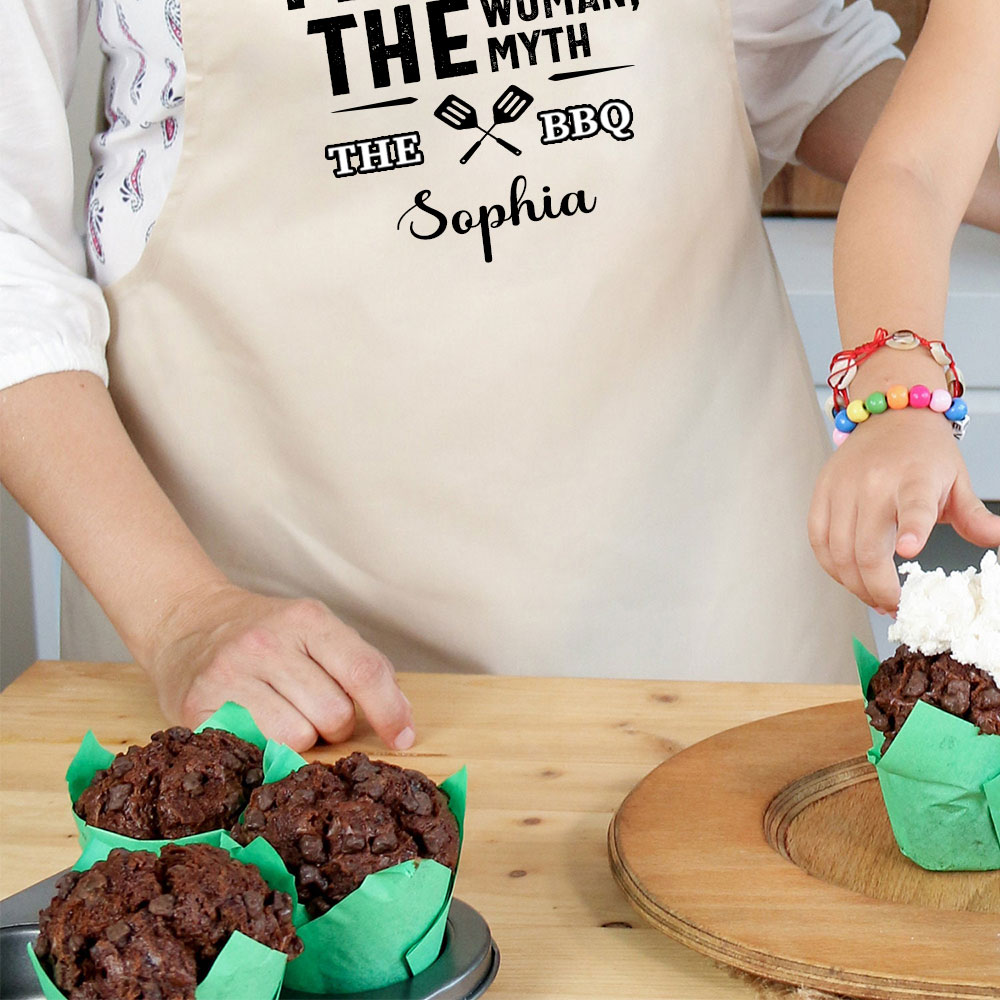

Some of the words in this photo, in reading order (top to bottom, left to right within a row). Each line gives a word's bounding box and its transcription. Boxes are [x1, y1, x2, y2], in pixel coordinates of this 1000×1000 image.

[487, 22, 591, 73] MYTH
[325, 131, 424, 178] THE
[537, 99, 635, 145] BBQ
[396, 175, 597, 264] Sophia
